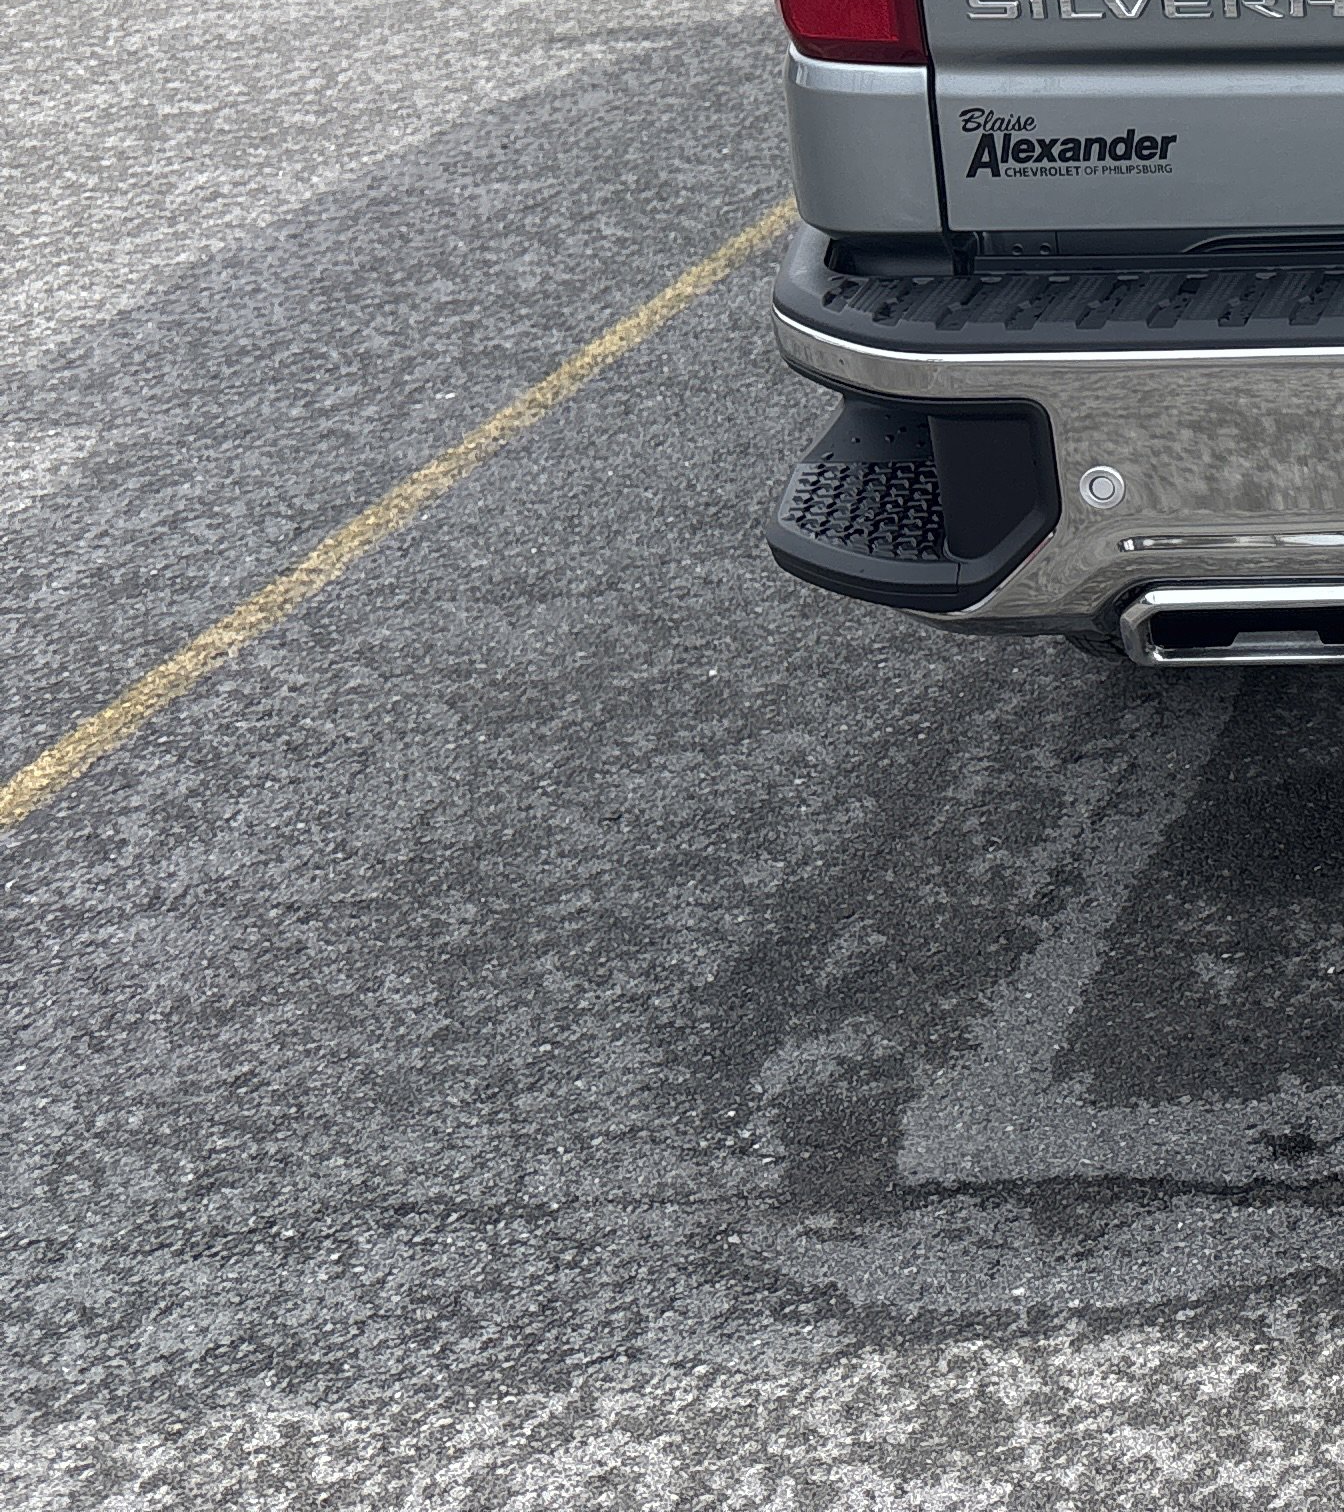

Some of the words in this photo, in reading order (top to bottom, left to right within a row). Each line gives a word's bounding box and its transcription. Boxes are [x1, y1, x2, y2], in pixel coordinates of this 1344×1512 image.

[959, 107, 1037, 133] Blaise
[966, 128, 1178, 178] Alexander
[1004, 166, 1081, 178] CHEVROLET
[1084, 165, 1100, 177] OF
[1101, 163, 1174, 176] PHILIPSBURG
